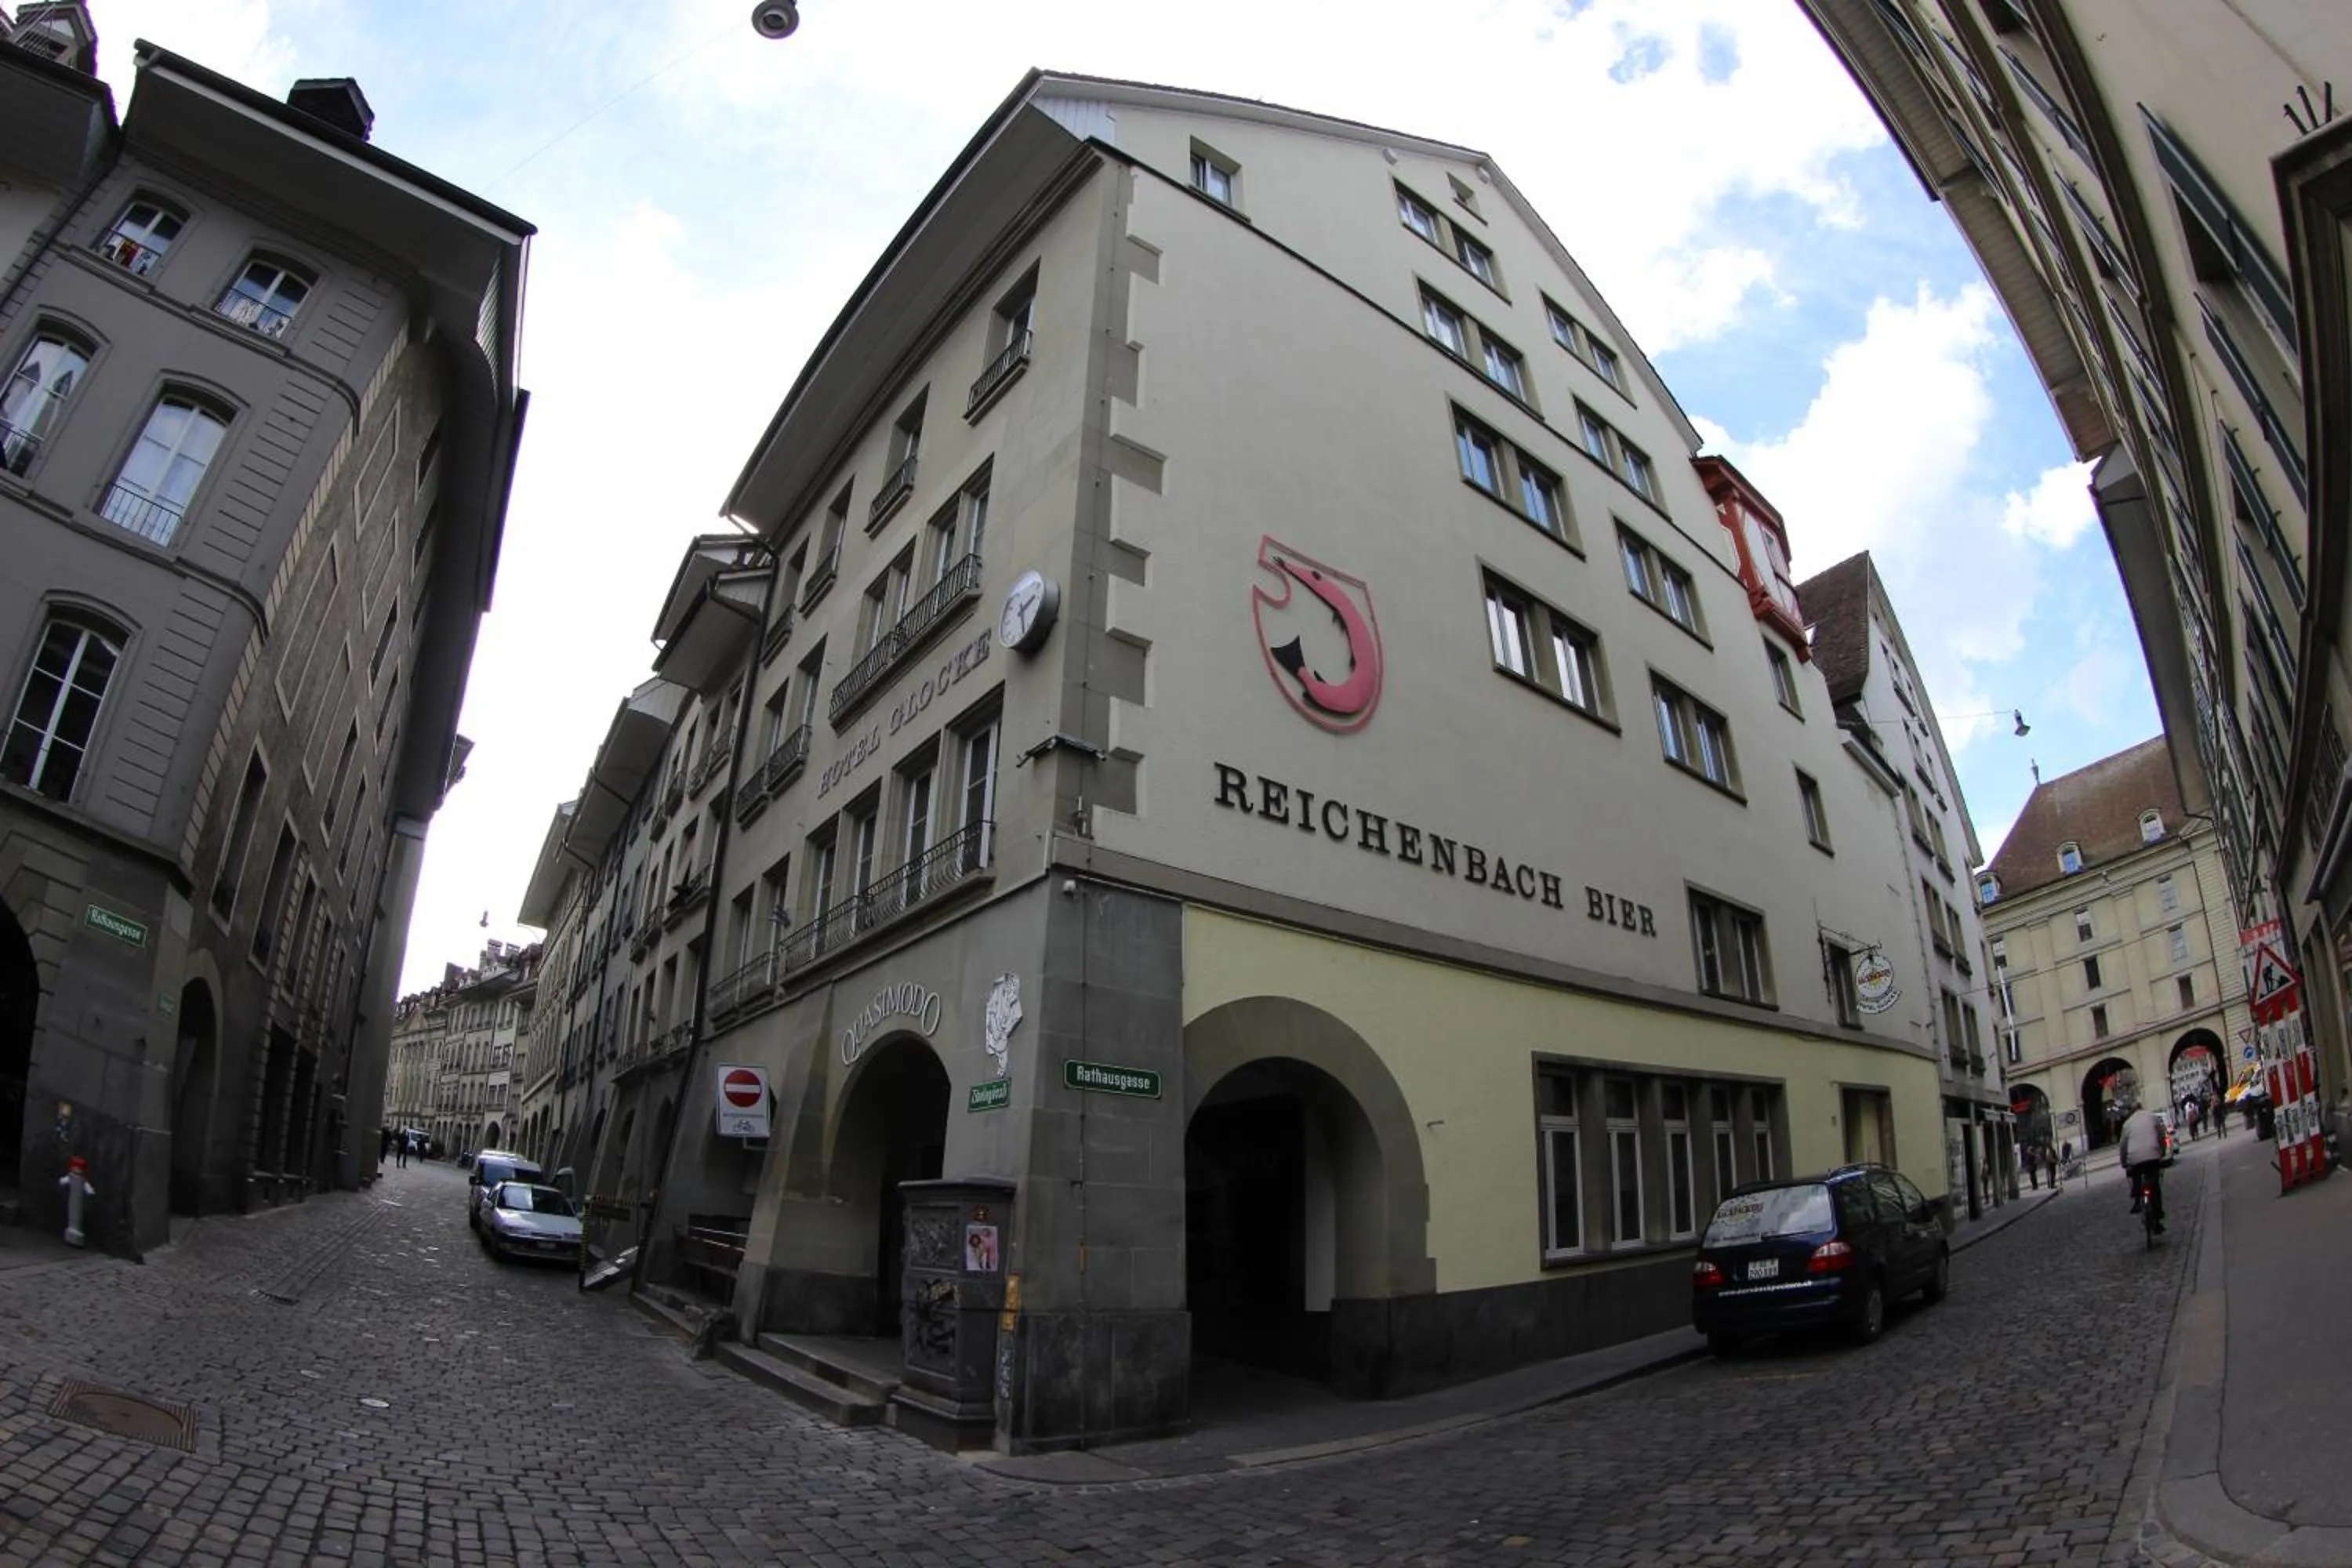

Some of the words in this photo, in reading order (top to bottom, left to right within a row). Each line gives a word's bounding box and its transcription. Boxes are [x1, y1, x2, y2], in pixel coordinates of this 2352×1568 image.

[817, 725, 880, 800] HOTEL
[890, 627, 992, 737] GLOCKE
[1214, 761, 1563, 910] REICHENBACH
[1584, 886, 1657, 938] BIER
[842, 982, 940, 1065] QUASIMODO
[1076, 1065, 1151, 1090] Rathausgasse
